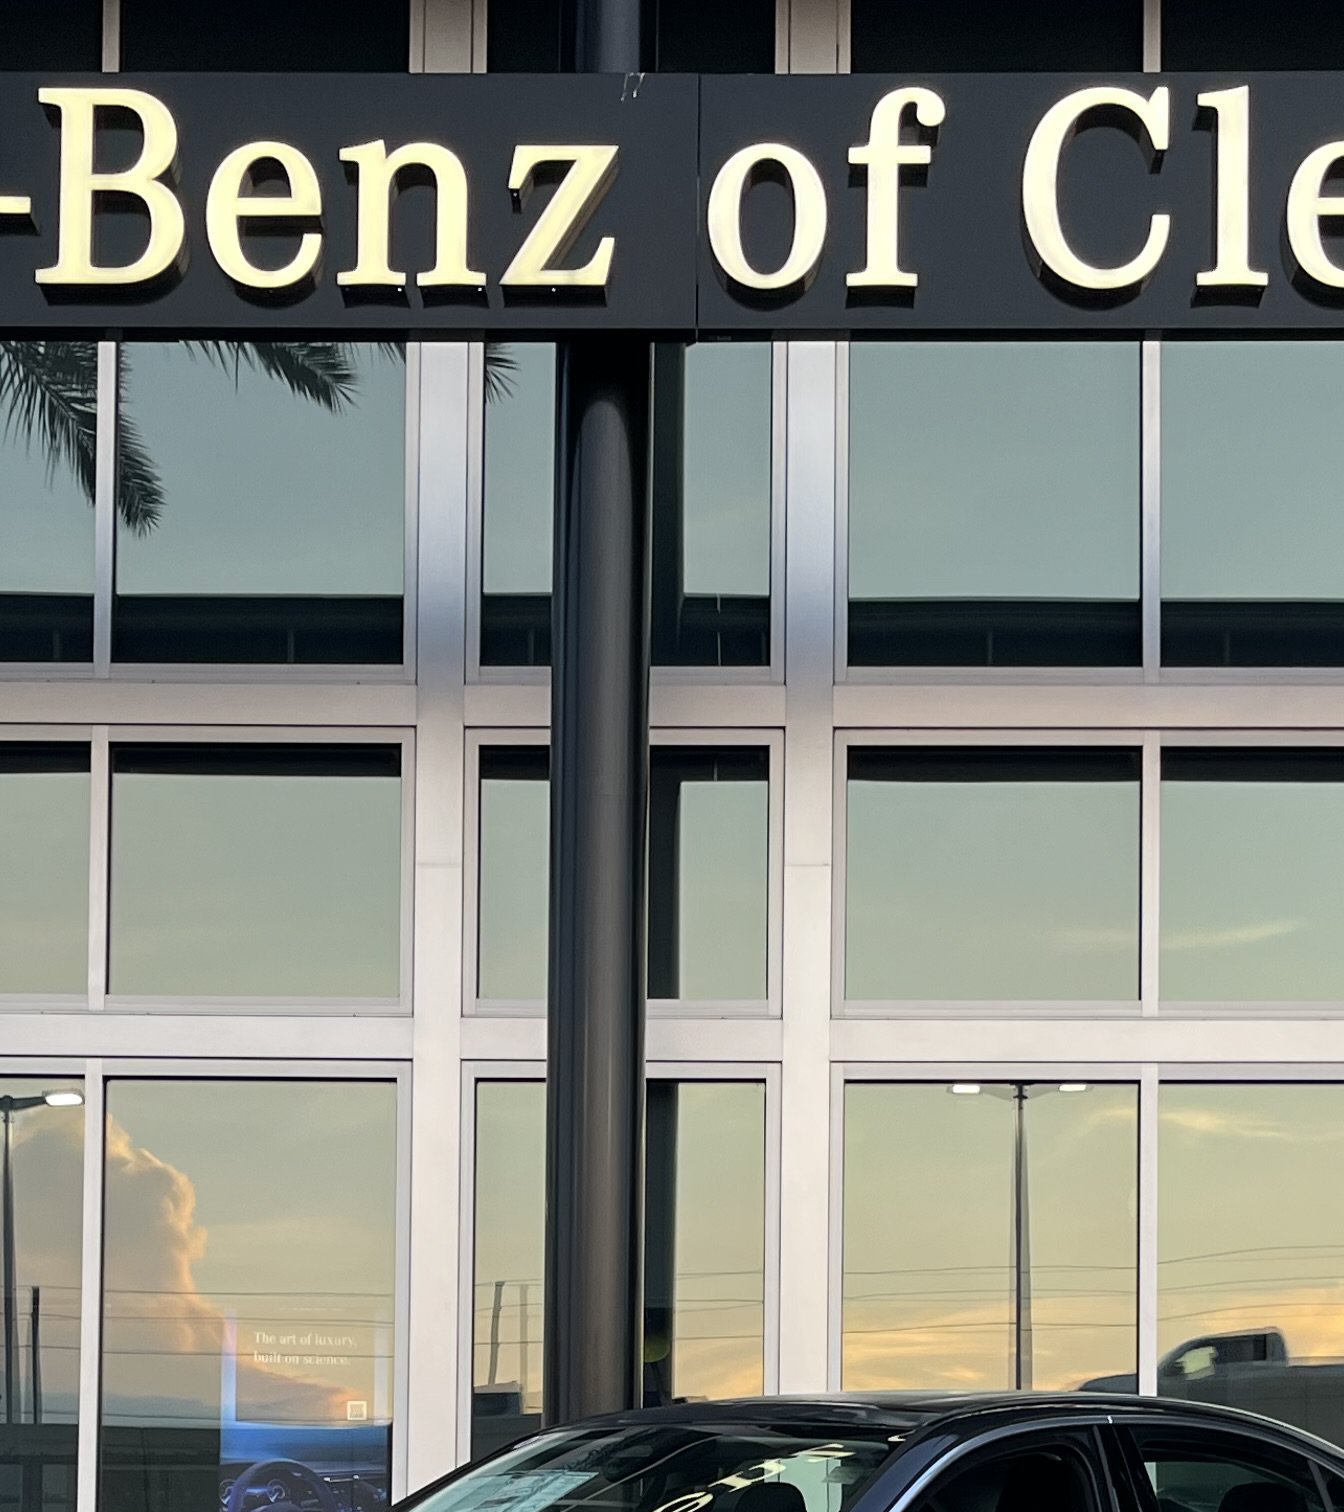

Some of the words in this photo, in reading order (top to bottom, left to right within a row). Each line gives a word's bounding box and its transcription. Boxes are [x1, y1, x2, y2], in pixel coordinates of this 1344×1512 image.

[708, 88, 944, 288] of
[255, 1331, 276, 1344] The
[279, 1333, 296, 1345] art
[300, 1332, 312, 1345] of
[254, 1350, 281, 1364] built
[284, 1355, 299, 1365] on
